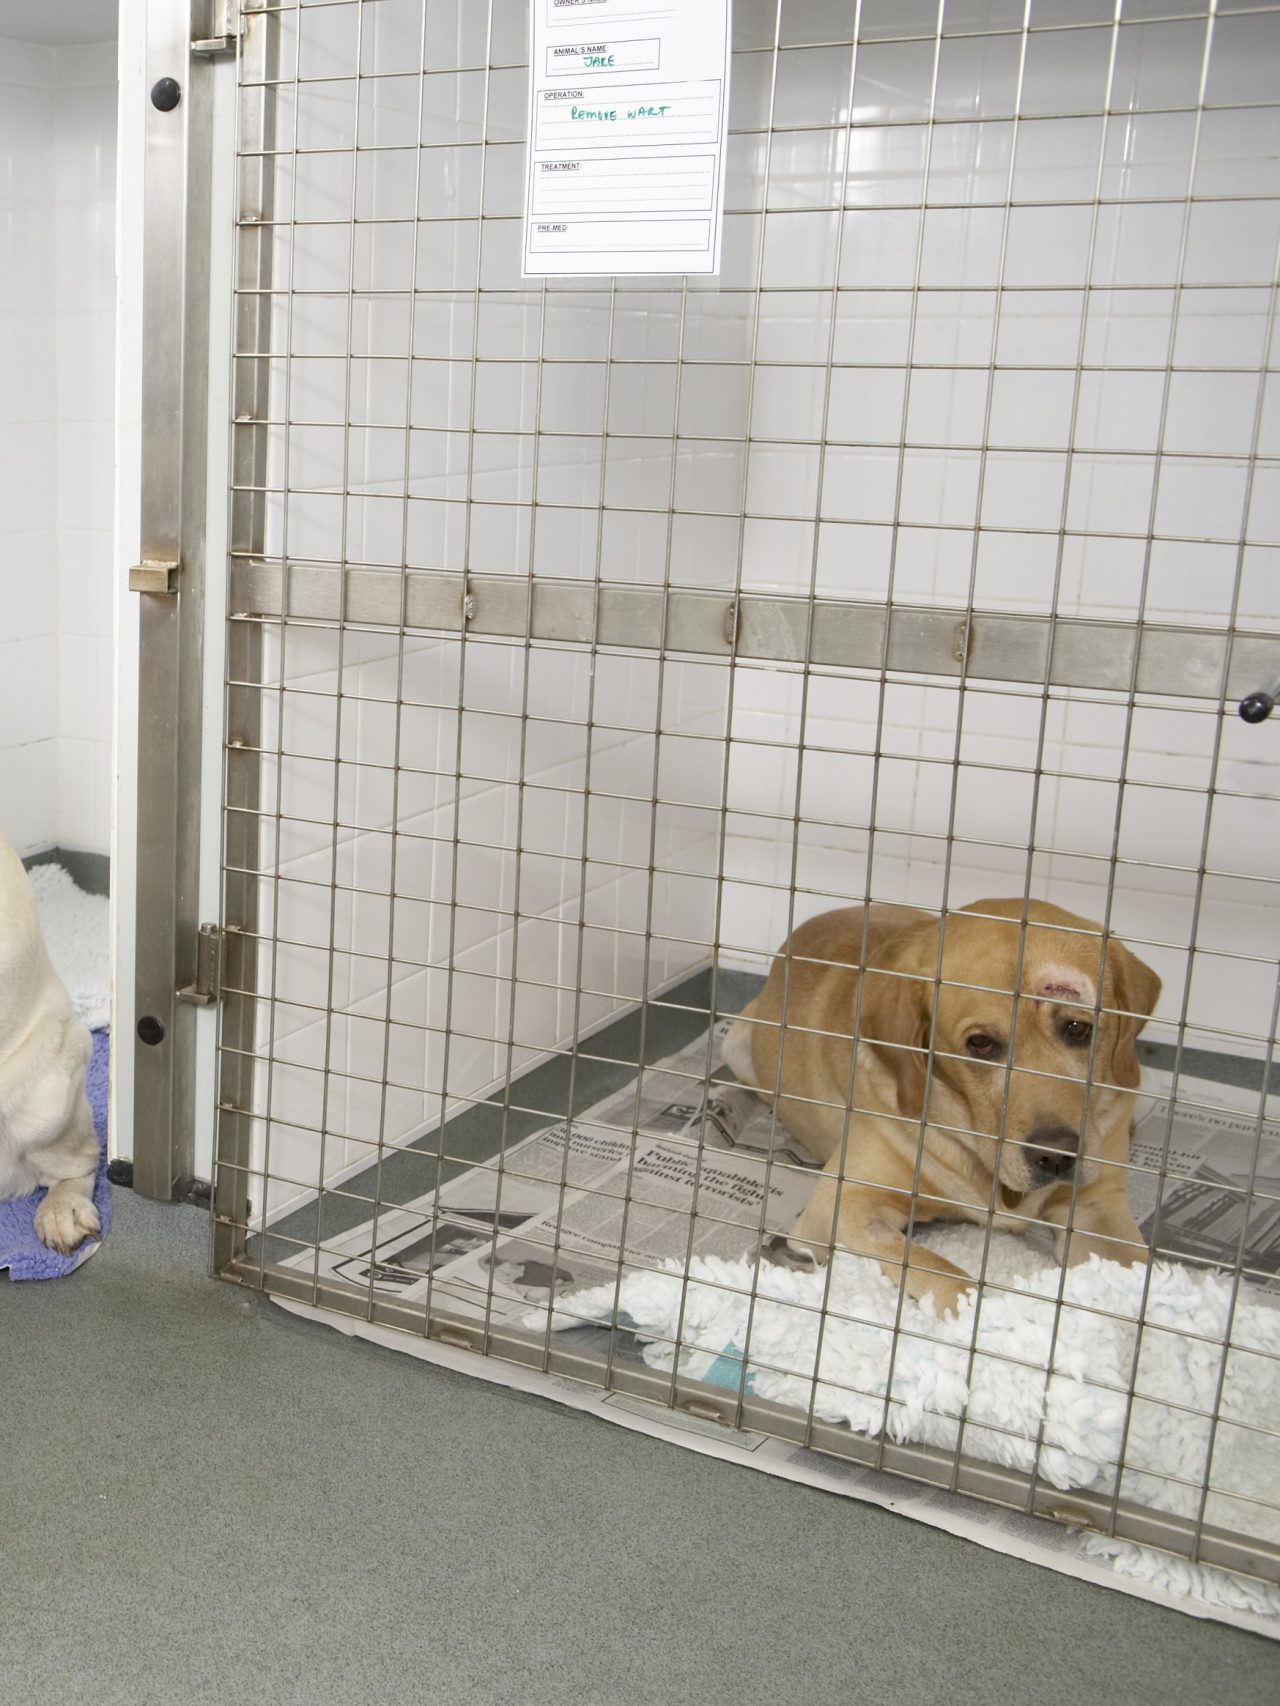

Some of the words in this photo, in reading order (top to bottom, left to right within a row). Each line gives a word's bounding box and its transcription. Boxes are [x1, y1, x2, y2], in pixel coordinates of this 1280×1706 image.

[583, 55, 615, 67] JAKE
[627, 105, 672, 120] WART
[646, 1150, 694, 1168] Public
[704, 1174, 728, 1187] the
